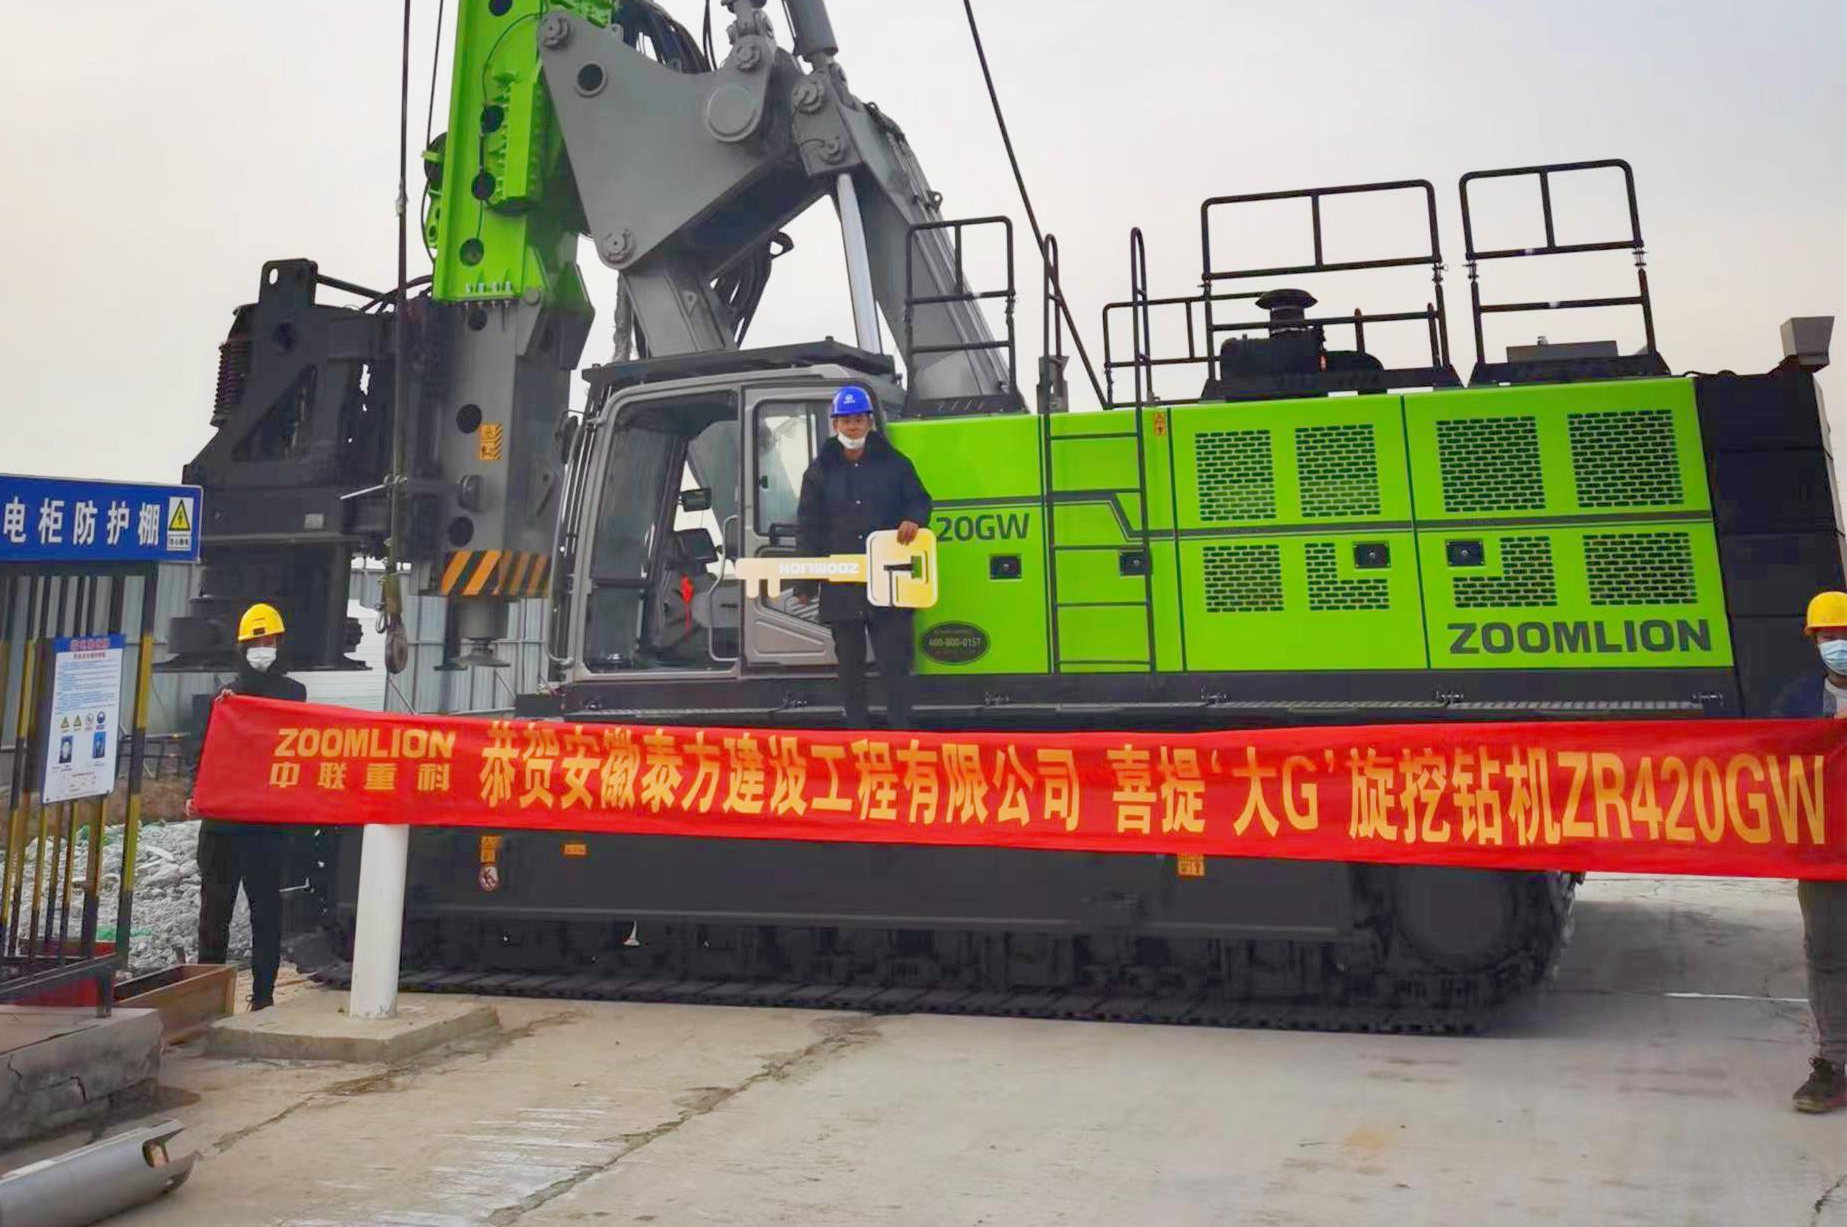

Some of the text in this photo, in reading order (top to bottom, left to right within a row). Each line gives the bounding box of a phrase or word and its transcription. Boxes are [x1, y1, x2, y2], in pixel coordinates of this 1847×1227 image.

[3, 495, 161, 546] 电柜防护棚
[779, 562, 860, 574] ZOOMLION
[1447, 619, 1712, 654] ZOOMLION
[274, 728, 456, 758] ZOOMLION
[269, 762, 451, 791] 中联重科
[480, 721, 1080, 832] 恭贺安徽泰方建设工程有限公司
